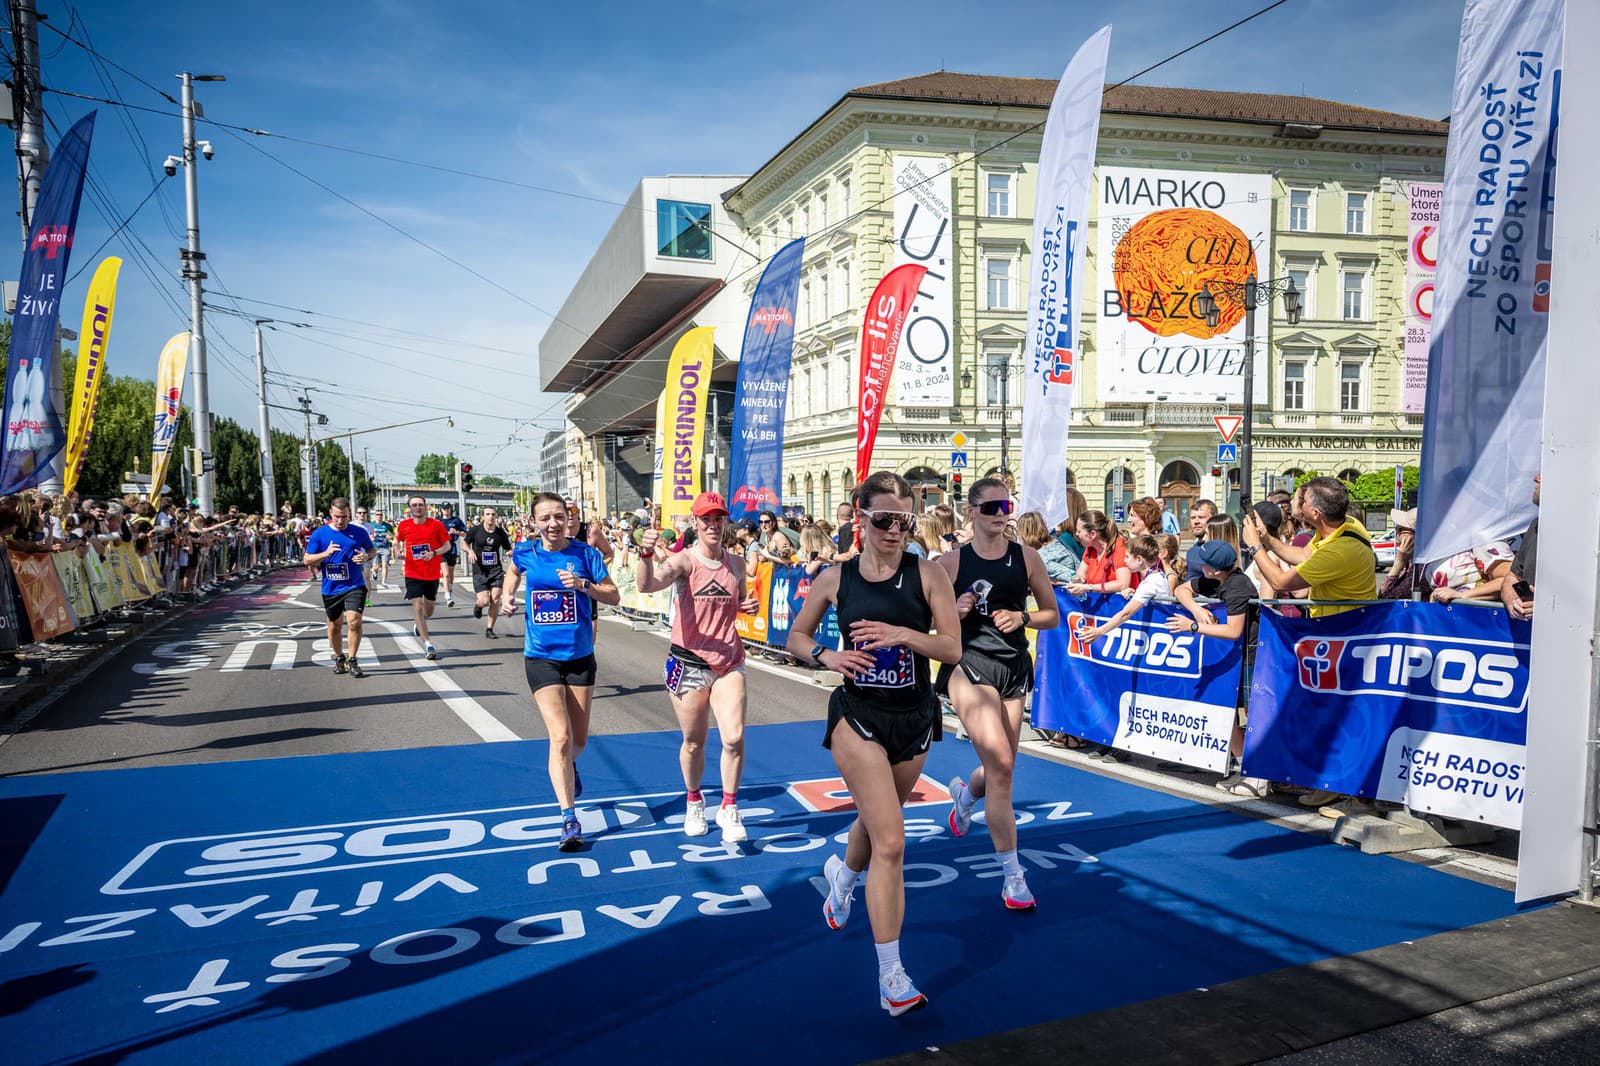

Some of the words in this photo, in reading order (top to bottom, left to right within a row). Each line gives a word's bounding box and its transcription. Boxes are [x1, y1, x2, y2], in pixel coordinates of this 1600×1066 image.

[1509, 50, 1544, 149] VÍŤAZÍ
[1476, 82, 1508, 206] RADOSŤ
[1104, 175, 1226, 209] MARKO
[1411, 196, 1440, 210] ktoré
[1111, 216, 1122, 247] 2024
[1411, 211, 1440, 222] zosta
[1492, 159, 1530, 283] ŠPORTU
[1185, 231, 1265, 266] CELÝ
[1467, 217, 1494, 299] NECH
[39, 273, 55, 292] JE
[1495, 292, 1518, 336] ZO
[1033, 318, 1045, 374] NECH
[1407, 336, 1426, 344] 2024
[742, 380, 787, 392] VYVÁŽENÉ
[926, 374, 950, 387] 2024
[740, 397, 784, 408] MINERÁLY
[673, 360, 702, 501] PERSKINDOL
[741, 427, 758, 440] VÁŠ
[760, 430, 777, 441] BEH
[752, 414, 769, 424] PRE
[1235, 435, 1303, 449] SOVENSKÁ
[748, 490, 769, 501] ŽIVOT
[534, 611, 564, 622] 4339
[131, 636, 382, 676] BUS
[1101, 627, 1195, 669] TIPOS
[1351, 643, 1519, 699] TIPOS
[1128, 704, 1158, 722] NECH
[1161, 711, 1208, 731] RADOSŤ
[1128, 720, 1143, 734] ZO
[1145, 721, 1188, 744] ŠPORTU
[1191, 732, 1228, 753] VÍŤAZ
[1412, 766, 1498, 798] ŠPORTU
[1445, 754, 1526, 780] RADOS
[142, 884, 773, 1014] RADOSŤ
